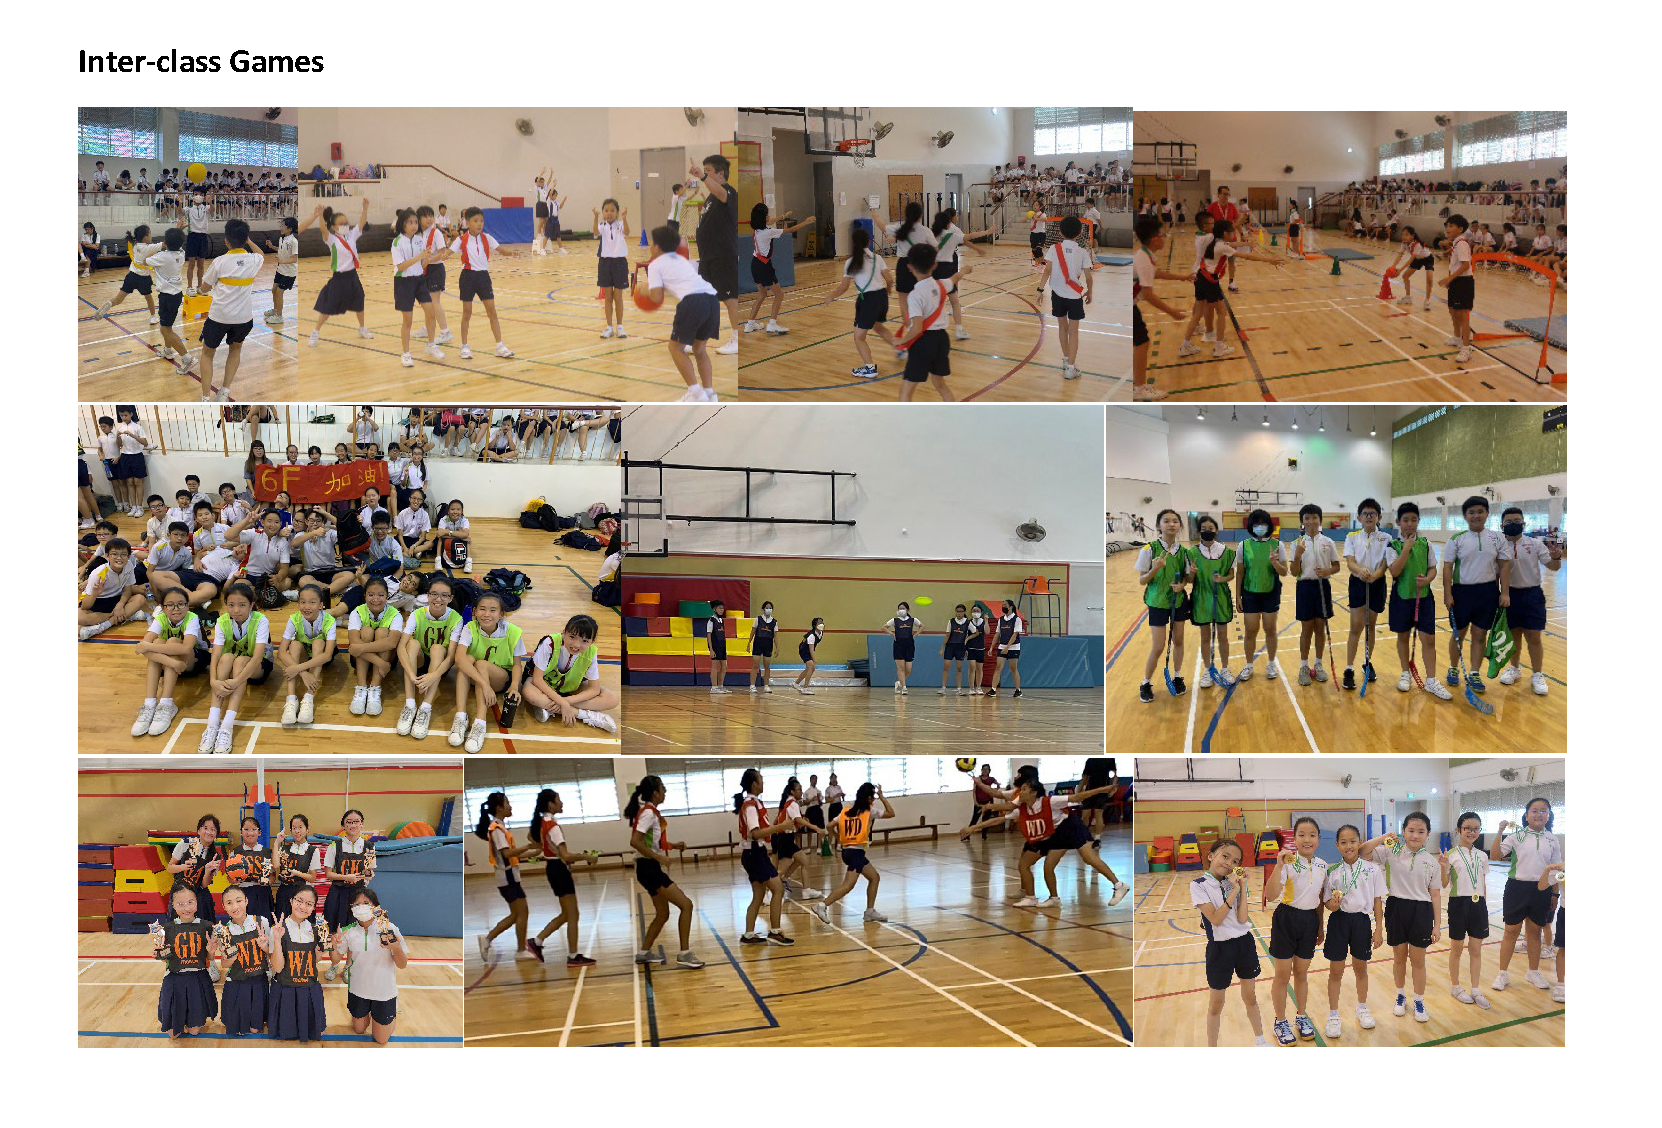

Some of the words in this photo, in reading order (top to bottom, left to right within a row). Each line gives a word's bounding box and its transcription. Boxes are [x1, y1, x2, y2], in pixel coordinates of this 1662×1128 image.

[261, 466, 301, 492] 6F
[844, 818, 862, 837] WD
[1025, 819, 1046, 837] WD
[174, 931, 202, 959] GD
[288, 950, 315, 977] WA
